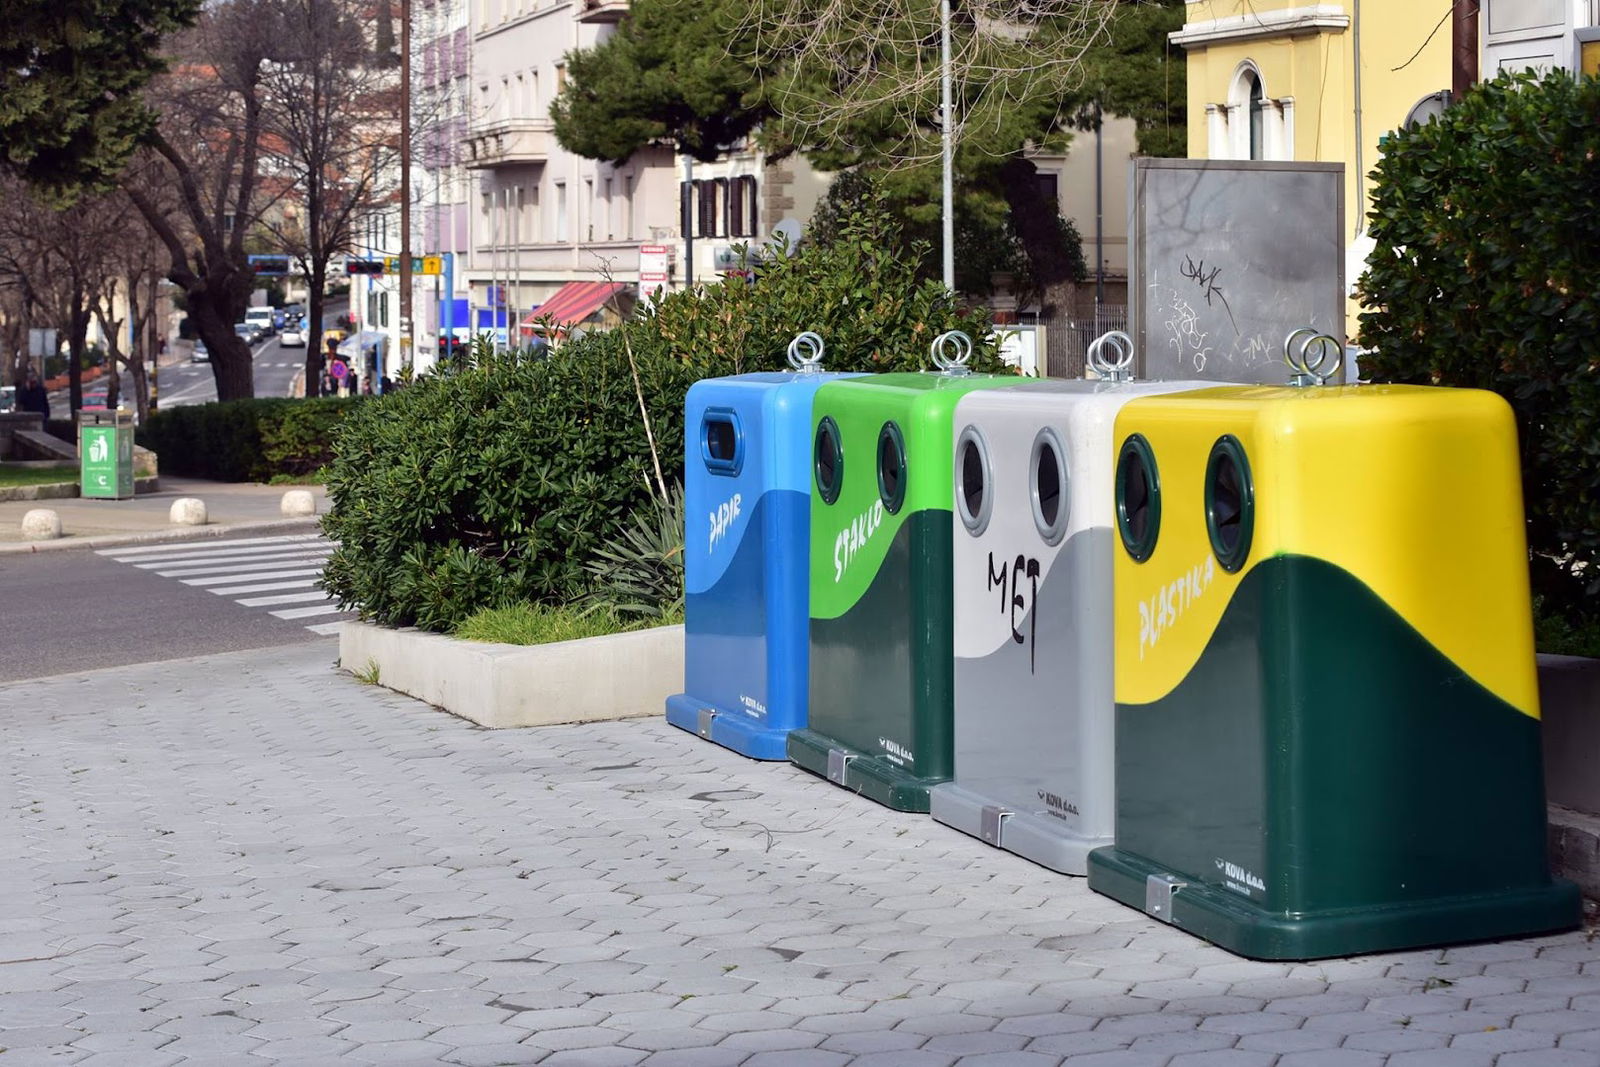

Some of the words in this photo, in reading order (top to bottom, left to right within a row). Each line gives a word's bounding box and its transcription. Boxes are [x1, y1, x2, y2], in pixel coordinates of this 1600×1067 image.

[709, 493, 742, 554] PAPIR
[834, 498, 883, 584] STAKLO
[988, 551, 1040, 675] MET
[1138, 554, 1215, 662] PLASTIKA
[1045, 791, 1063, 810] KOVA
[1063, 799, 1080, 816] d.o.o.
[1225, 861, 1245, 883] KOVA
[1246, 871, 1266, 891] d.o.o.
